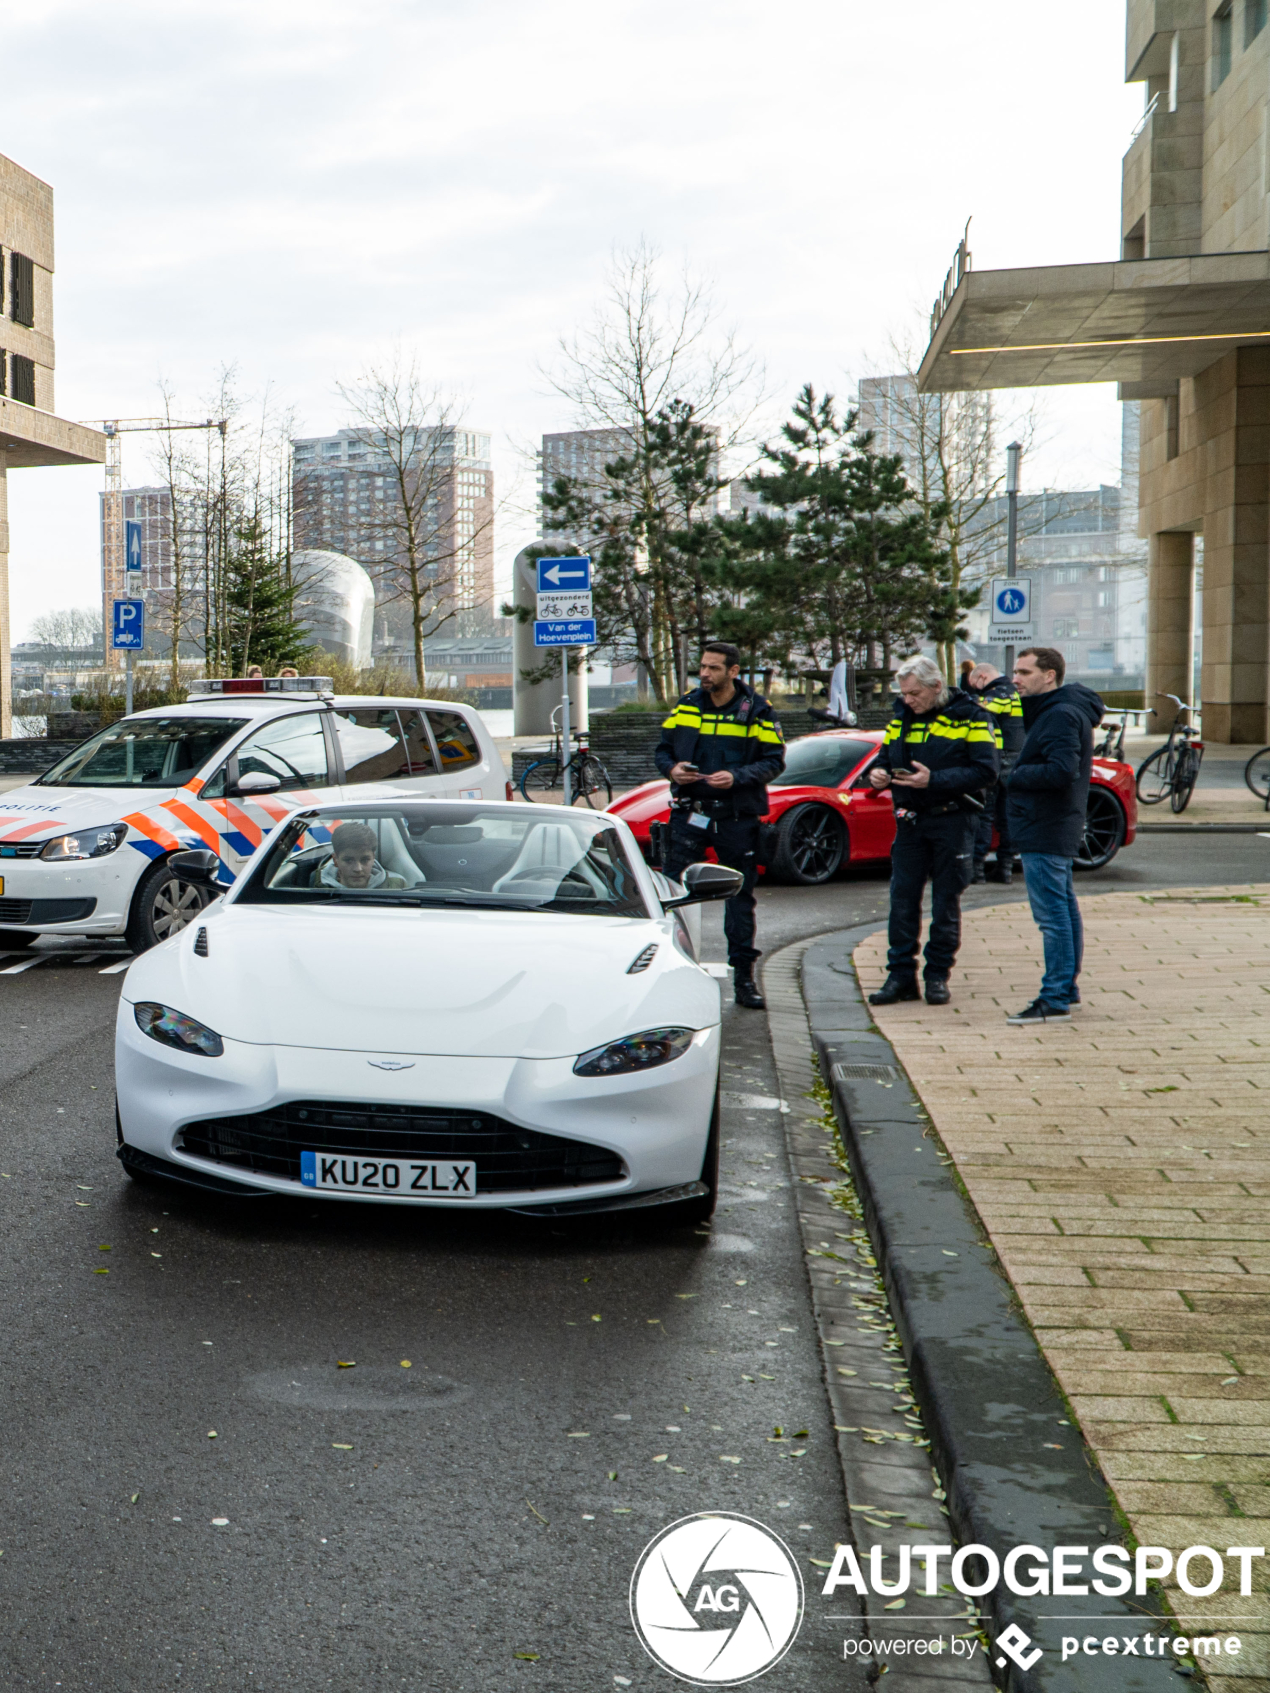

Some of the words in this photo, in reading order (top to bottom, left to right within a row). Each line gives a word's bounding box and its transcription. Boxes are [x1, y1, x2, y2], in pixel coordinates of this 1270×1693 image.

[539, 594, 590, 603] uitgezonderd
[120, 604, 137, 629] P
[548, 623, 566, 632] Van
[567, 623, 582, 631] der
[538, 632, 592, 642] Hoevenplein
[990, 635, 1032, 643] toegestaan
[303, 1172, 314, 1180] GB
[321, 1158, 400, 1189] KU20
[410, 1164, 471, 1192] ZLX
